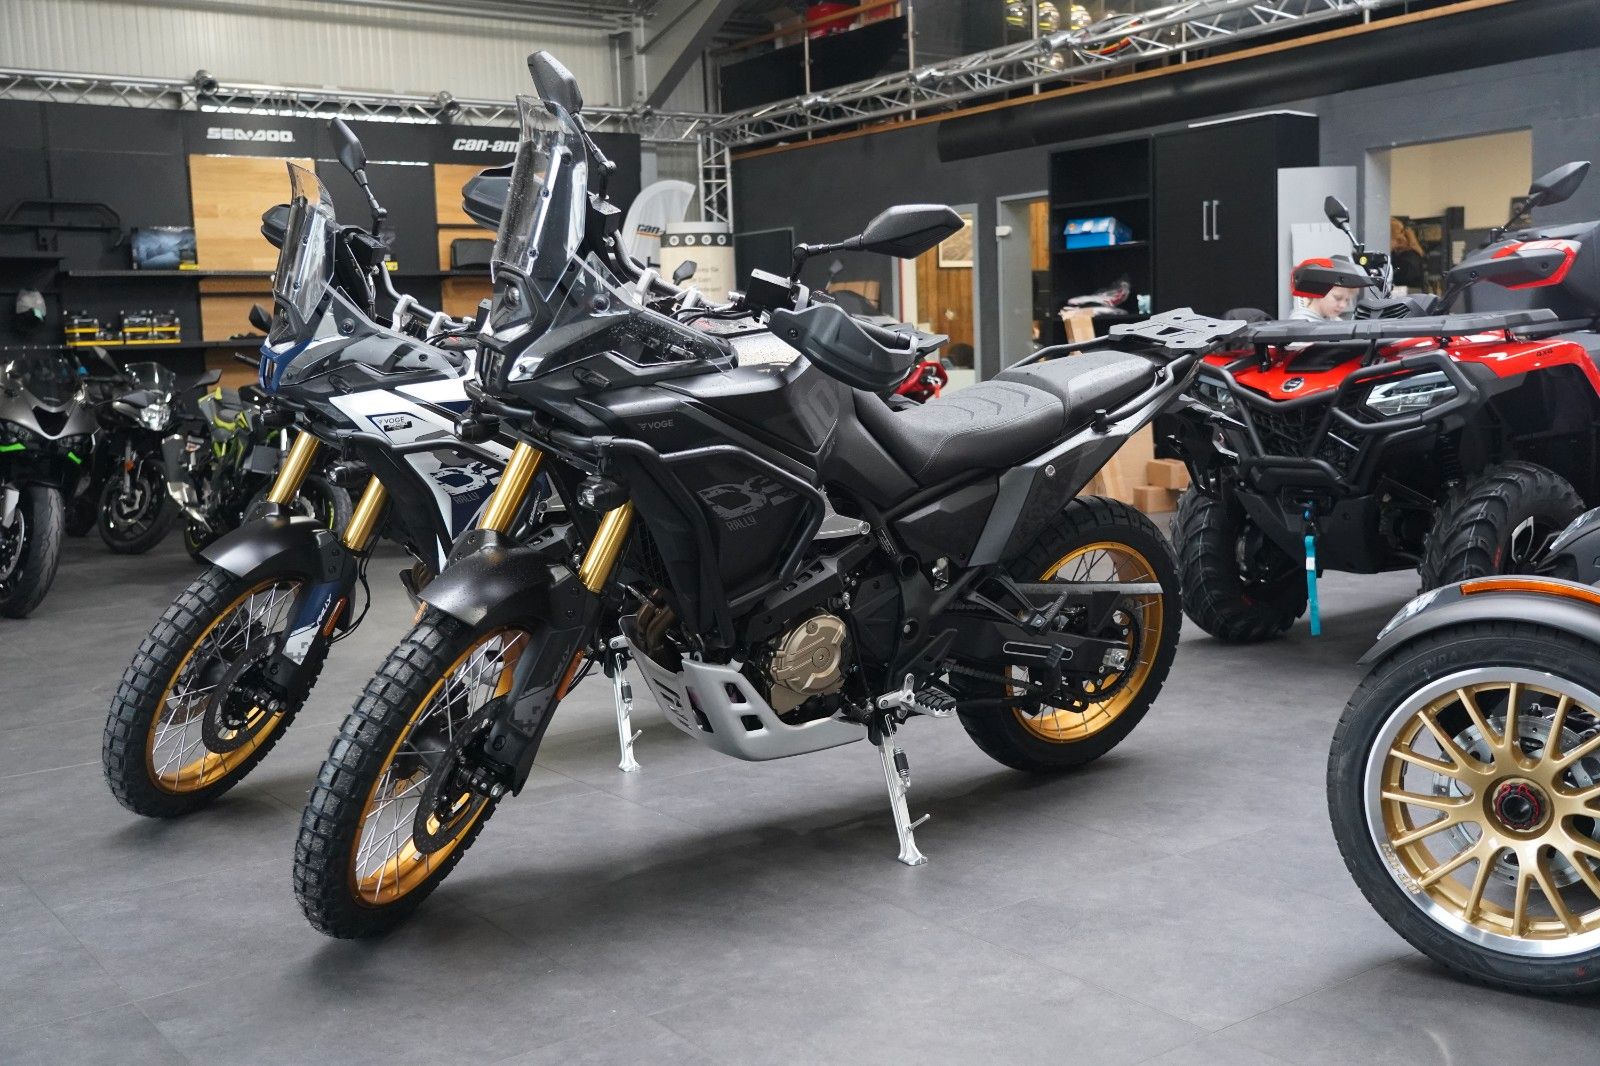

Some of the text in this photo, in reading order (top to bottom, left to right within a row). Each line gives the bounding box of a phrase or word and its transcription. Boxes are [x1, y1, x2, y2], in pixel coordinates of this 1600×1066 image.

[384, 416, 405, 424] VOGE
[647, 419, 674, 430] VOGE
[726, 514, 757, 532] RALLY
